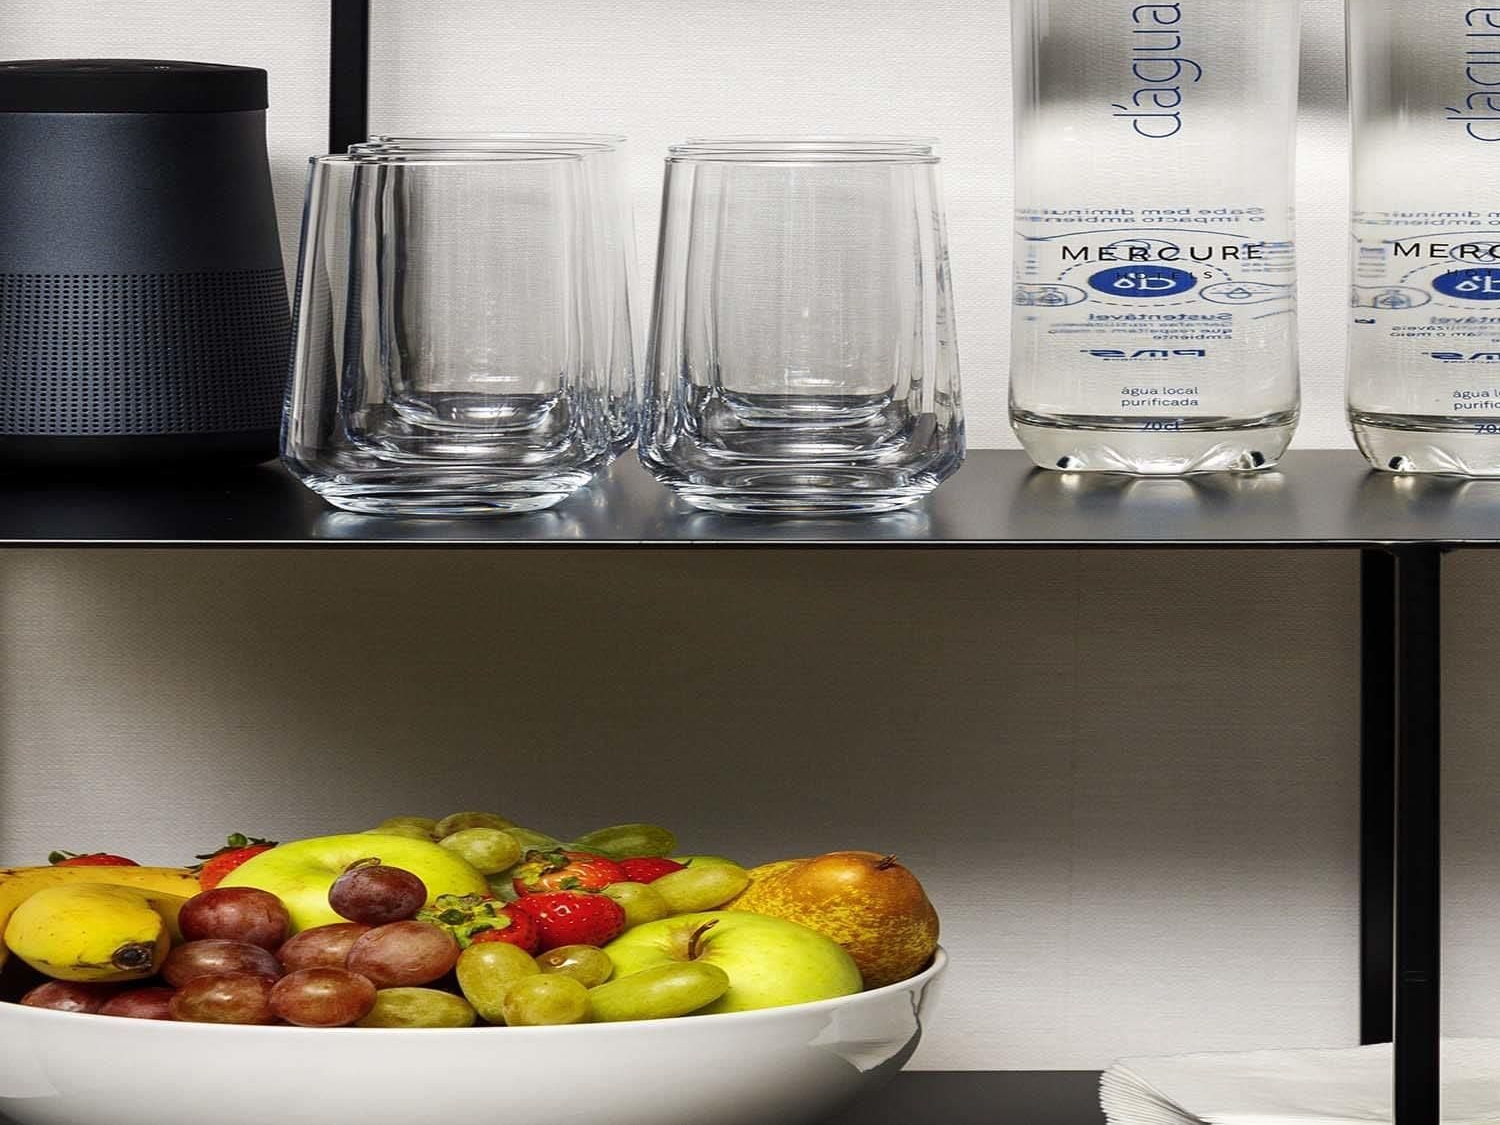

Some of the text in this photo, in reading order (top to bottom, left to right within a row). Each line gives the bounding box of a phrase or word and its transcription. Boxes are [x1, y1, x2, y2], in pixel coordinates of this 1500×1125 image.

[1061, 245, 1263, 262] MERCURE
[1120, 386, 1199, 396] água local
[1452, 388, 1490, 399] água
[1120, 397, 1199, 408] purificada
